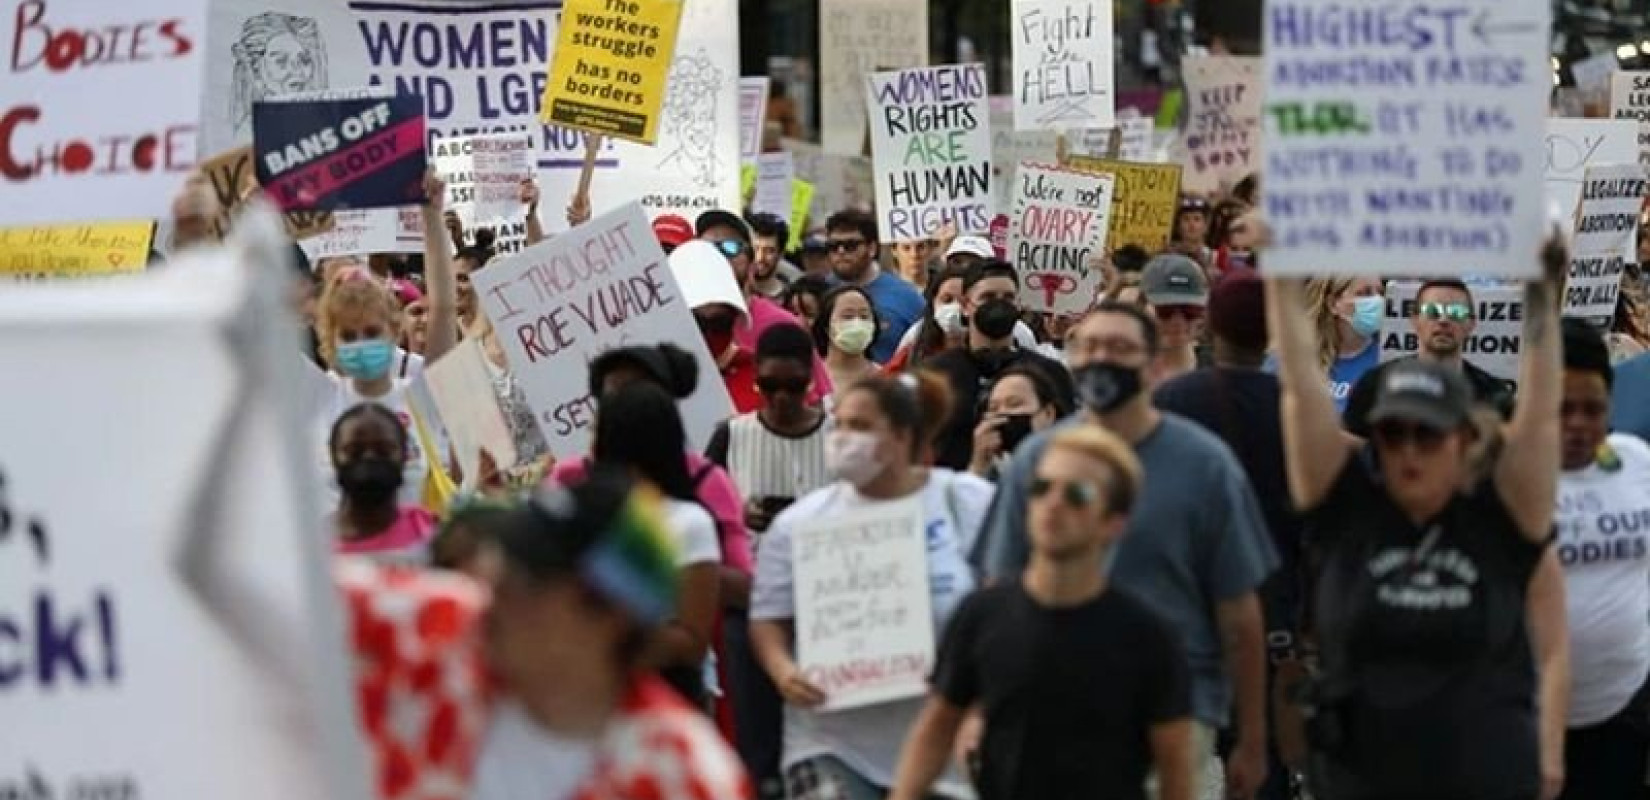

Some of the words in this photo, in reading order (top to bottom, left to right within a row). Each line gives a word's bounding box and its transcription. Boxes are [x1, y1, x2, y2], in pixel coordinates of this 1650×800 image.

[11, 0, 193, 73] BODIES
[576, 13, 659, 39] workers
[1020, 3, 1098, 54] Fight
[1272, 4, 1468, 51] HIGHEST
[571, 32, 656, 58] struggle
[575, 59, 610, 79] has
[616, 69, 642, 85] no
[1022, 61, 1106, 105] HELL
[1274, 55, 1416, 87] ABORTION
[369, 73, 455, 119] ND
[565, 76, 644, 105] borders
[263, 126, 340, 176] BANS
[341, 101, 391, 141] OFF
[884, 102, 978, 138] RIGHTS
[0, 105, 199, 181] CHOICE
[328, 133, 398, 182] BODY
[904, 130, 968, 166] ARE
[889, 160, 989, 207] HUMAN
[1075, 184, 1103, 203] not
[1583, 178, 1646, 200] LEGALIZE
[888, 204, 989, 240] RIGHTS
[1020, 203, 1094, 243] OVARY
[1578, 213, 1637, 233] ABORTION
[487, 281, 524, 322] I
[519, 221, 636, 303] THOUGHT
[1017, 240, 1091, 279] ACTING
[517, 306, 576, 363] ROE
[569, 292, 598, 335] V
[597, 262, 675, 328] WADE
[1385, 298, 1523, 321] LEIZE
[1384, 333, 1520, 353] ABION
